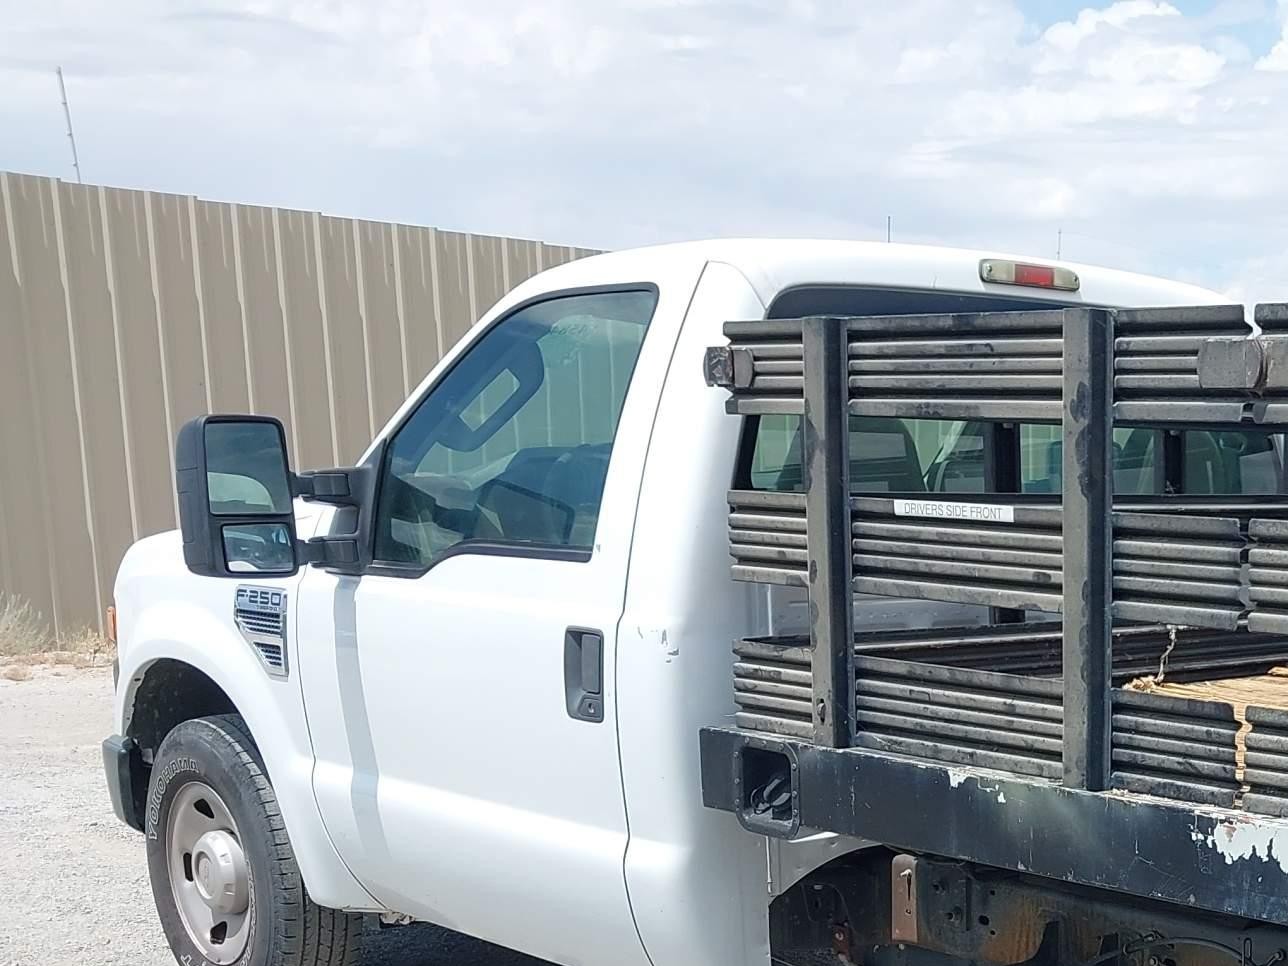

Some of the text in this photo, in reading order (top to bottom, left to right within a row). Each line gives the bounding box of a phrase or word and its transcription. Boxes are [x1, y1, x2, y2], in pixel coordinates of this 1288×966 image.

[904, 502, 1003, 520] DRIVERS SIDE FRONT
[236, 588, 282, 606] F-250
[148, 757, 199, 840] YOKOHAMA
